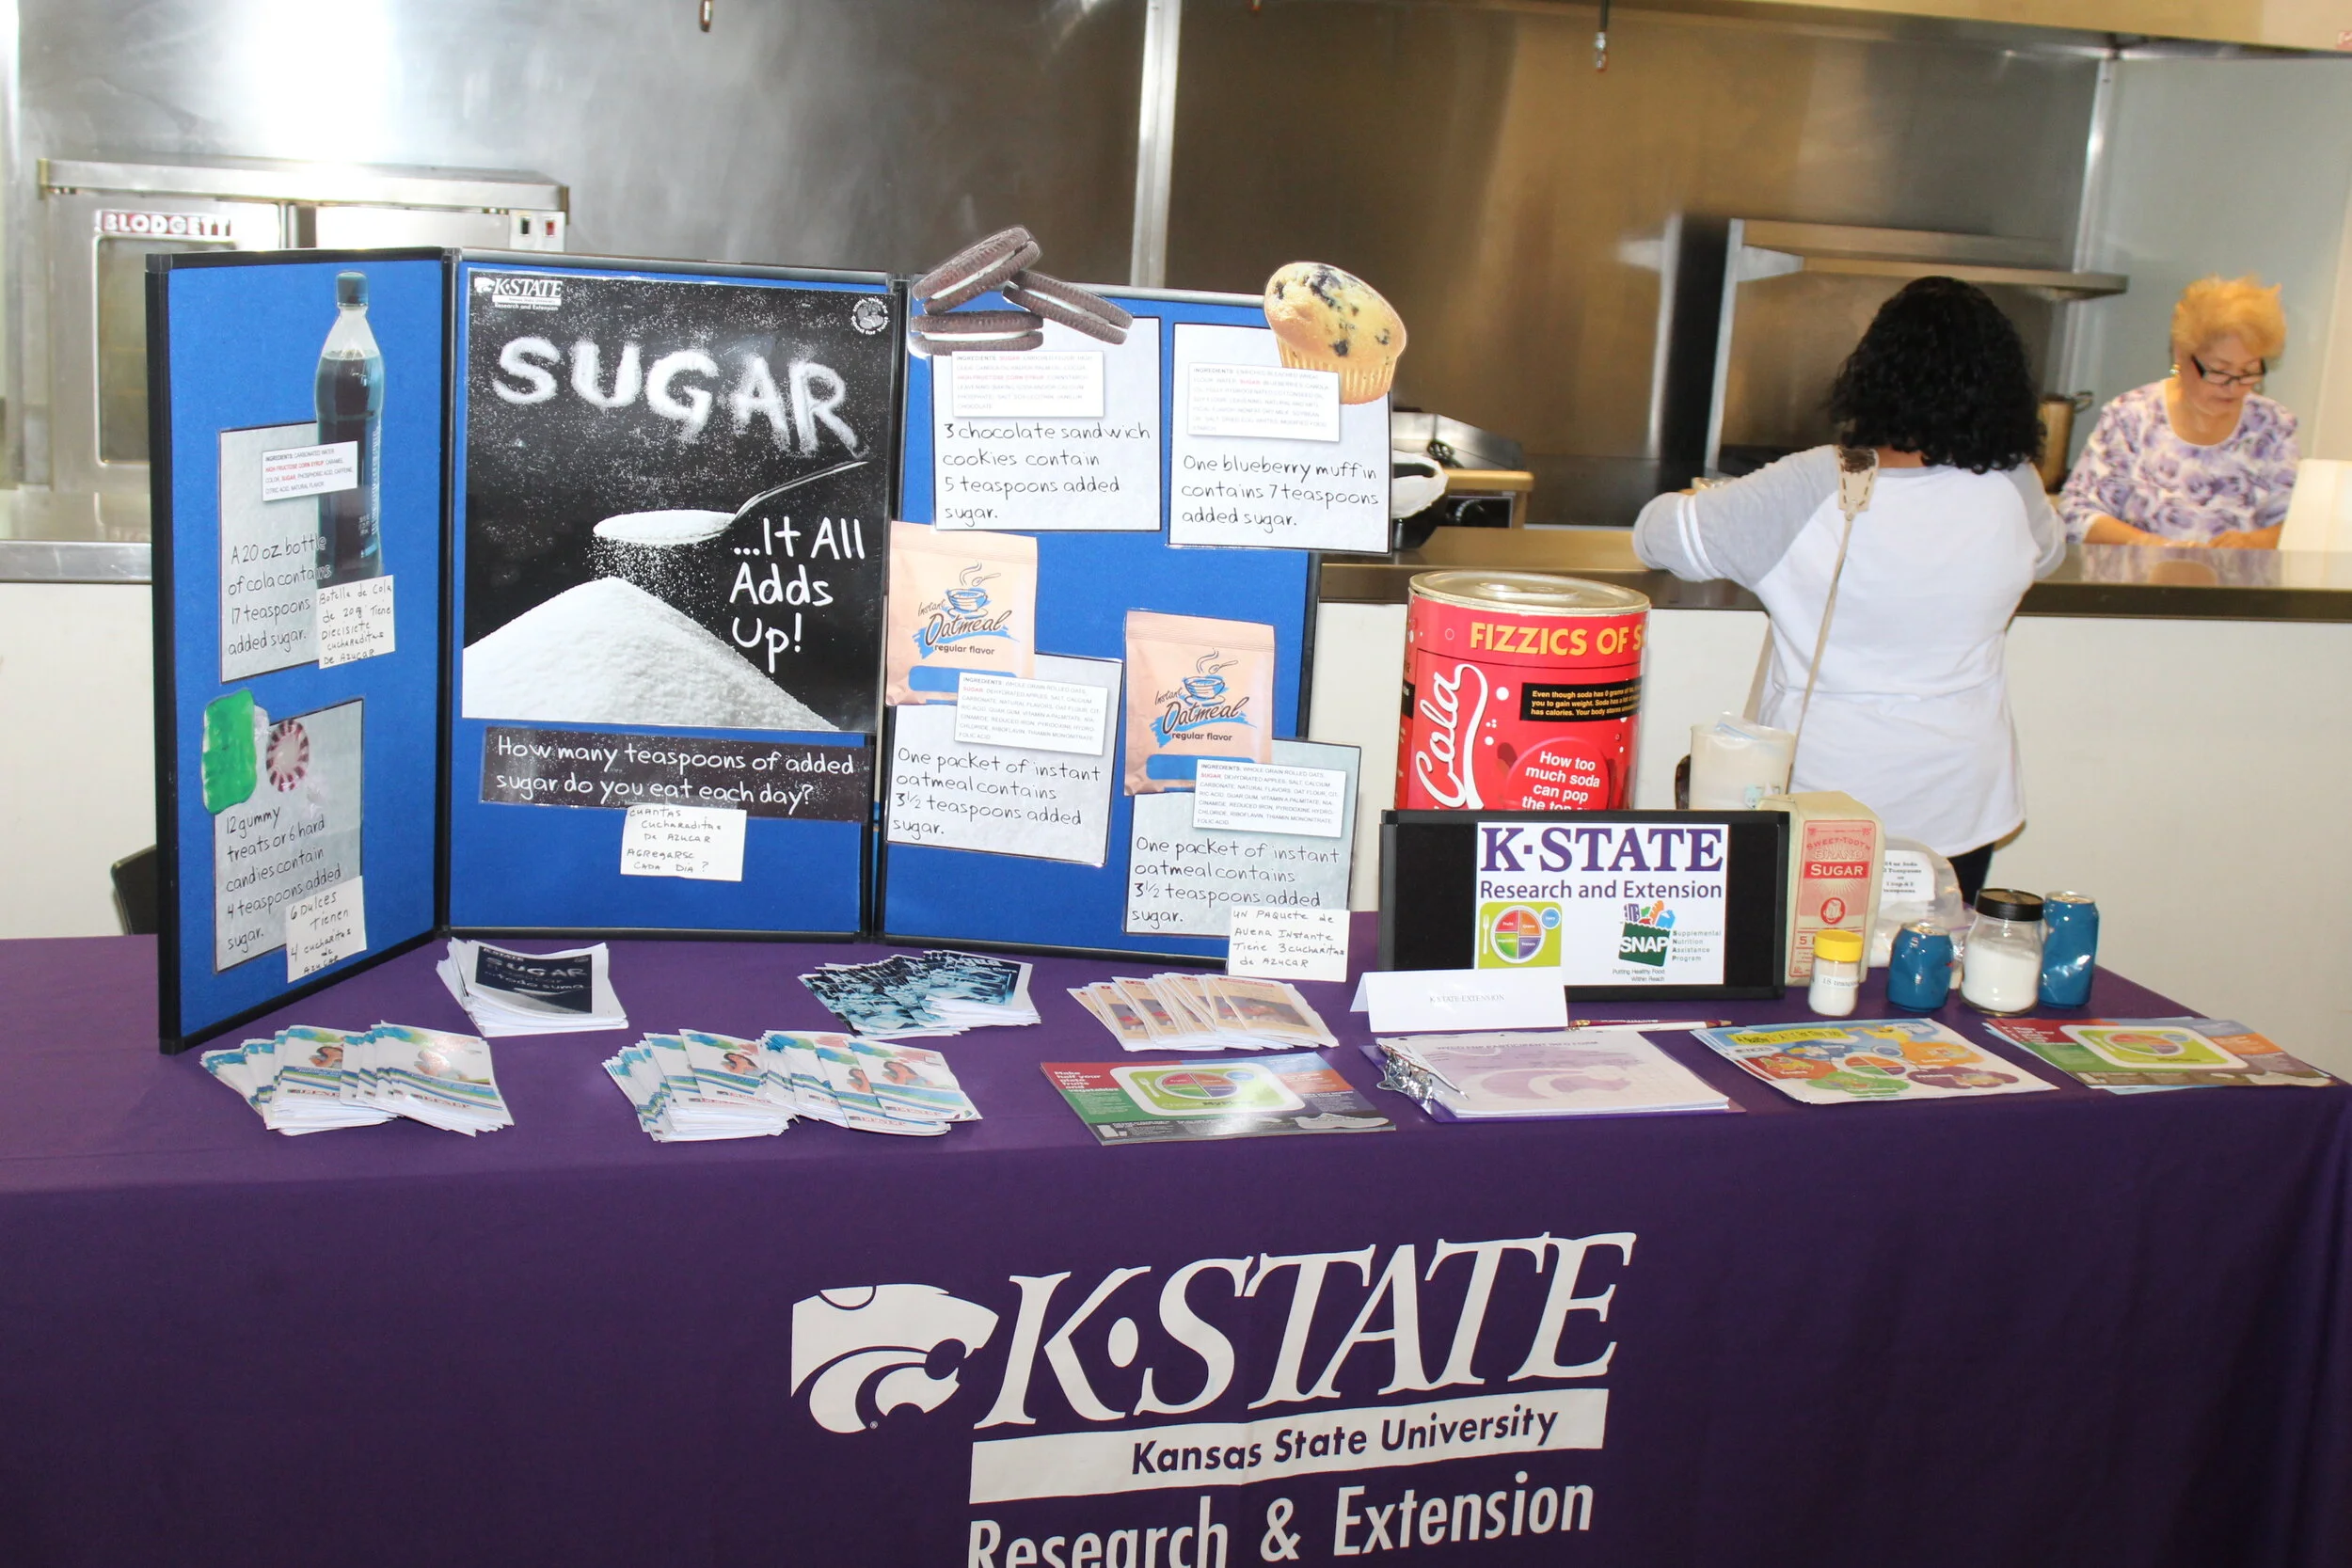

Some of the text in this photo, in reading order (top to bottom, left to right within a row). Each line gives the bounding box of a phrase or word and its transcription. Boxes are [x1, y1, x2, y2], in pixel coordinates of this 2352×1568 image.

[103, 213, 231, 236] BLODGETT
[492, 336, 869, 458] SUGAR
[944, 421, 1151, 440] 3 chocolate sandwich
[943, 448, 1100, 467] cookies contain
[1184, 454, 1376, 483] One blueberry muffin
[945, 476, 1120, 500] 5 teaspoons added
[1181, 481, 1379, 510] contains 7 teaspoons
[945, 506, 998, 528] sugar.
[1182, 506, 1297, 534] added sugar.
[231, 534, 327, 564] A 20 oz bottle
[810, 516, 866, 561] All
[228, 564, 332, 595] of cola contains
[729, 562, 834, 606] Adds
[231, 598, 310, 626] 17 teaspoons
[917, 599, 946, 617] Instant
[925, 610, 1013, 646] Oatmeal
[1470, 622, 1632, 656] FIZZICS OF
[228, 628, 307, 656] added sugar.
[732, 612, 802, 673] Up!
[934, 643, 995, 657] regular flavor
[1154, 688, 1184, 706] Instant
[1532, 700, 1545, 708] you
[1555, 700, 1570, 708] gain
[1571, 699, 1595, 708] weight.
[1551, 690, 1576, 700] though
[1162, 696, 1250, 735] Oatmeal
[1545, 707, 1575, 716] calories.
[1591, 708, 1606, 717] body
[1171, 731, 1233, 743] regular flavor
[1415, 663, 1488, 810] Cola
[498, 735, 854, 776] How many teaspoons of added
[898, 747, 1102, 782] One packet of instant
[1539, 751, 1596, 771] How too
[896, 771, 1057, 800] oatmeal contains
[1525, 767, 1600, 788] much soda
[496, 771, 814, 816] sugar do you eat each day?
[1521, 796, 1546, 811] the
[1533, 784, 1589, 804] can pop
[227, 805, 280, 839] 12 gummy
[927, 794, 1022, 822] teaspoons
[1026, 806, 1081, 826] added
[227, 814, 325, 863] treats or 6 hard
[893, 818, 945, 841] sugar.
[1136, 836, 1341, 863] One packet of instant
[1806, 836, 1871, 851] SWEET-TOOTH
[226, 847, 324, 892] candies contain
[1134, 860, 1295, 882] oatmeal contains
[1810, 863, 1864, 877] SUGAR
[228, 863, 342, 919] 4 teaspoons added
[1165, 882, 1261, 909] teaspoons
[1266, 889, 1321, 908] added
[1480, 879, 1723, 899] Research and Extension
[1132, 910, 1184, 930] sugar.
[1673, 929, 1722, 938] Supplemental
[228, 927, 264, 953] sugar.
[1620, 936, 1669, 953] SNAP
[485, 957, 588, 977] SUGAR
[1132, 1403, 1559, 1476] Kansas State University
[967, 1469, 1594, 1568] Research & Extension
